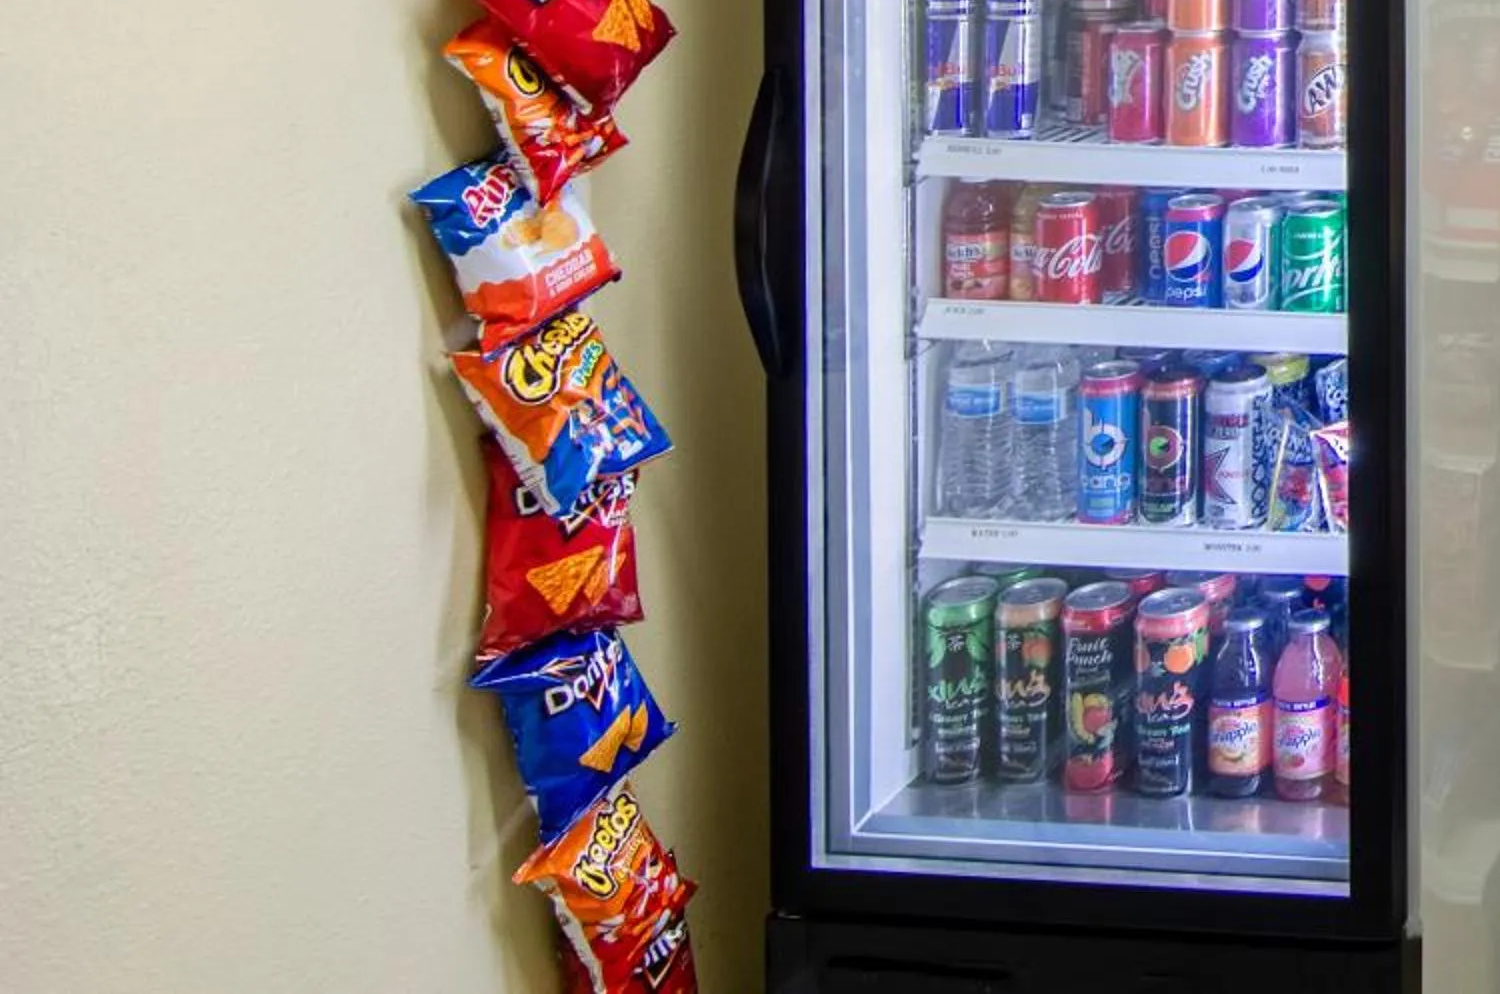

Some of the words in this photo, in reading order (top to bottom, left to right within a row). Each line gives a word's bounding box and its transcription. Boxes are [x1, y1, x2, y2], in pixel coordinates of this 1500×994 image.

[1177, 52, 1213, 110] Crush
[1239, 55, 1273, 112] Crush
[1166, 285, 1208, 302] pepsi
[503, 312, 596, 404] Cheetos
[545, 639, 623, 715] Doritos
[573, 791, 639, 899] Cheetos
